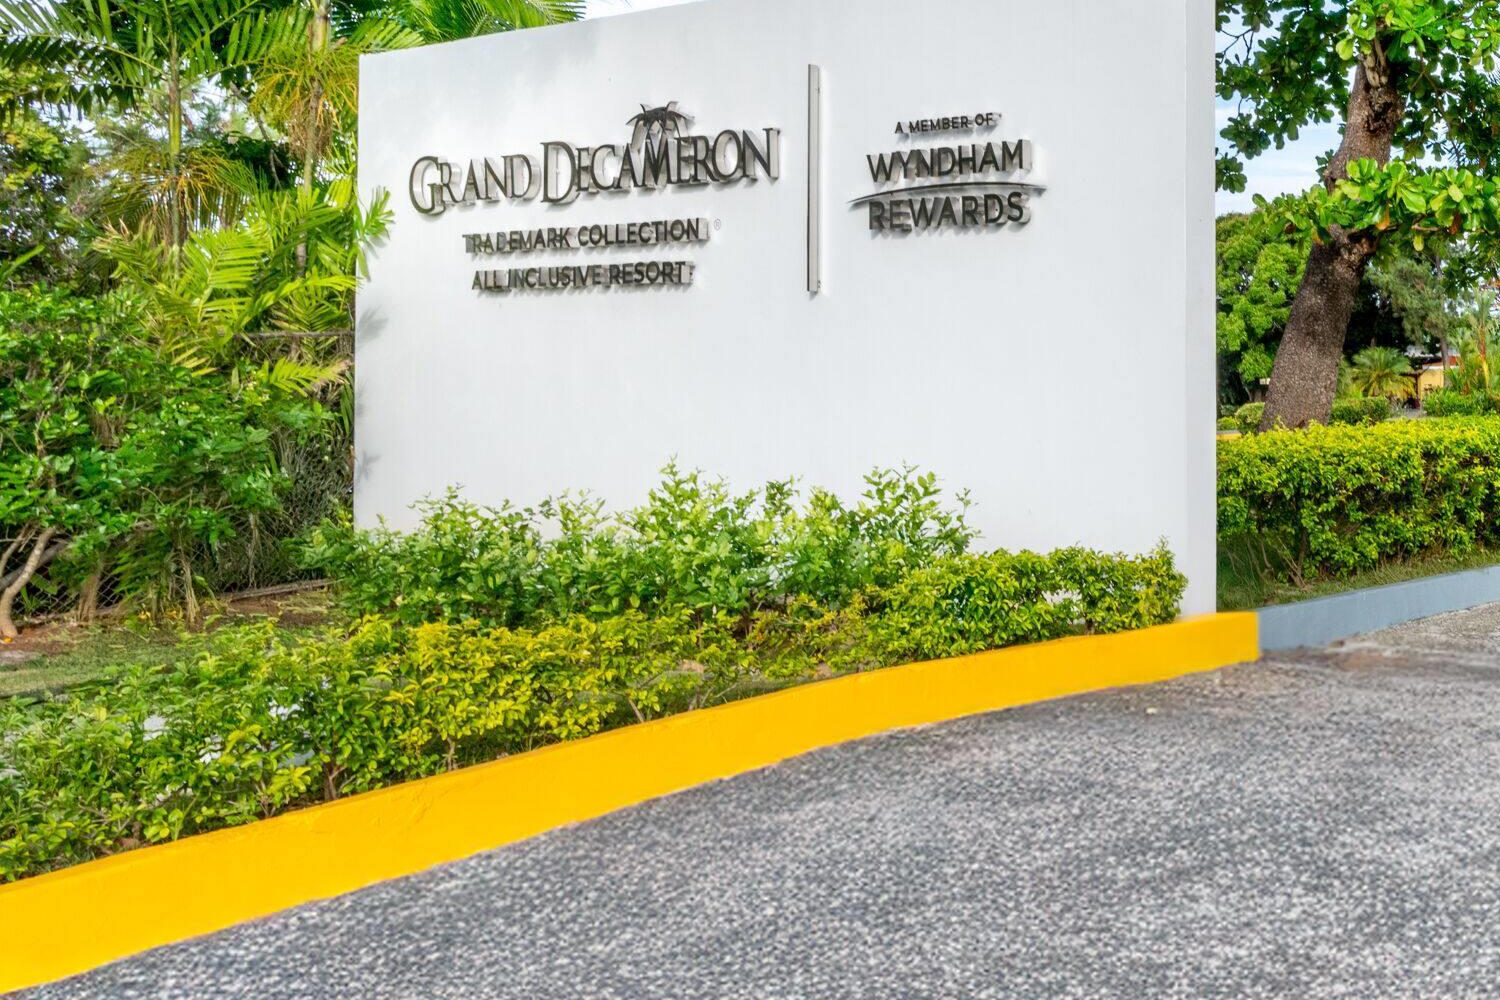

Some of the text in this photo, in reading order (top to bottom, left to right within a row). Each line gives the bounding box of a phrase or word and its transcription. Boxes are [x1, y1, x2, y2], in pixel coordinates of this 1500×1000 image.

[895, 112, 993, 134] A MEMBER OF
[409, 127, 779, 214] GRAND DECAMERON
[867, 139, 1026, 182] WYNDHAM
[868, 192, 1026, 230] REWARDS
[462, 227, 570, 253] TRADEMARK
[472, 260, 690, 291] ALL INCLUSIVE RESORT
